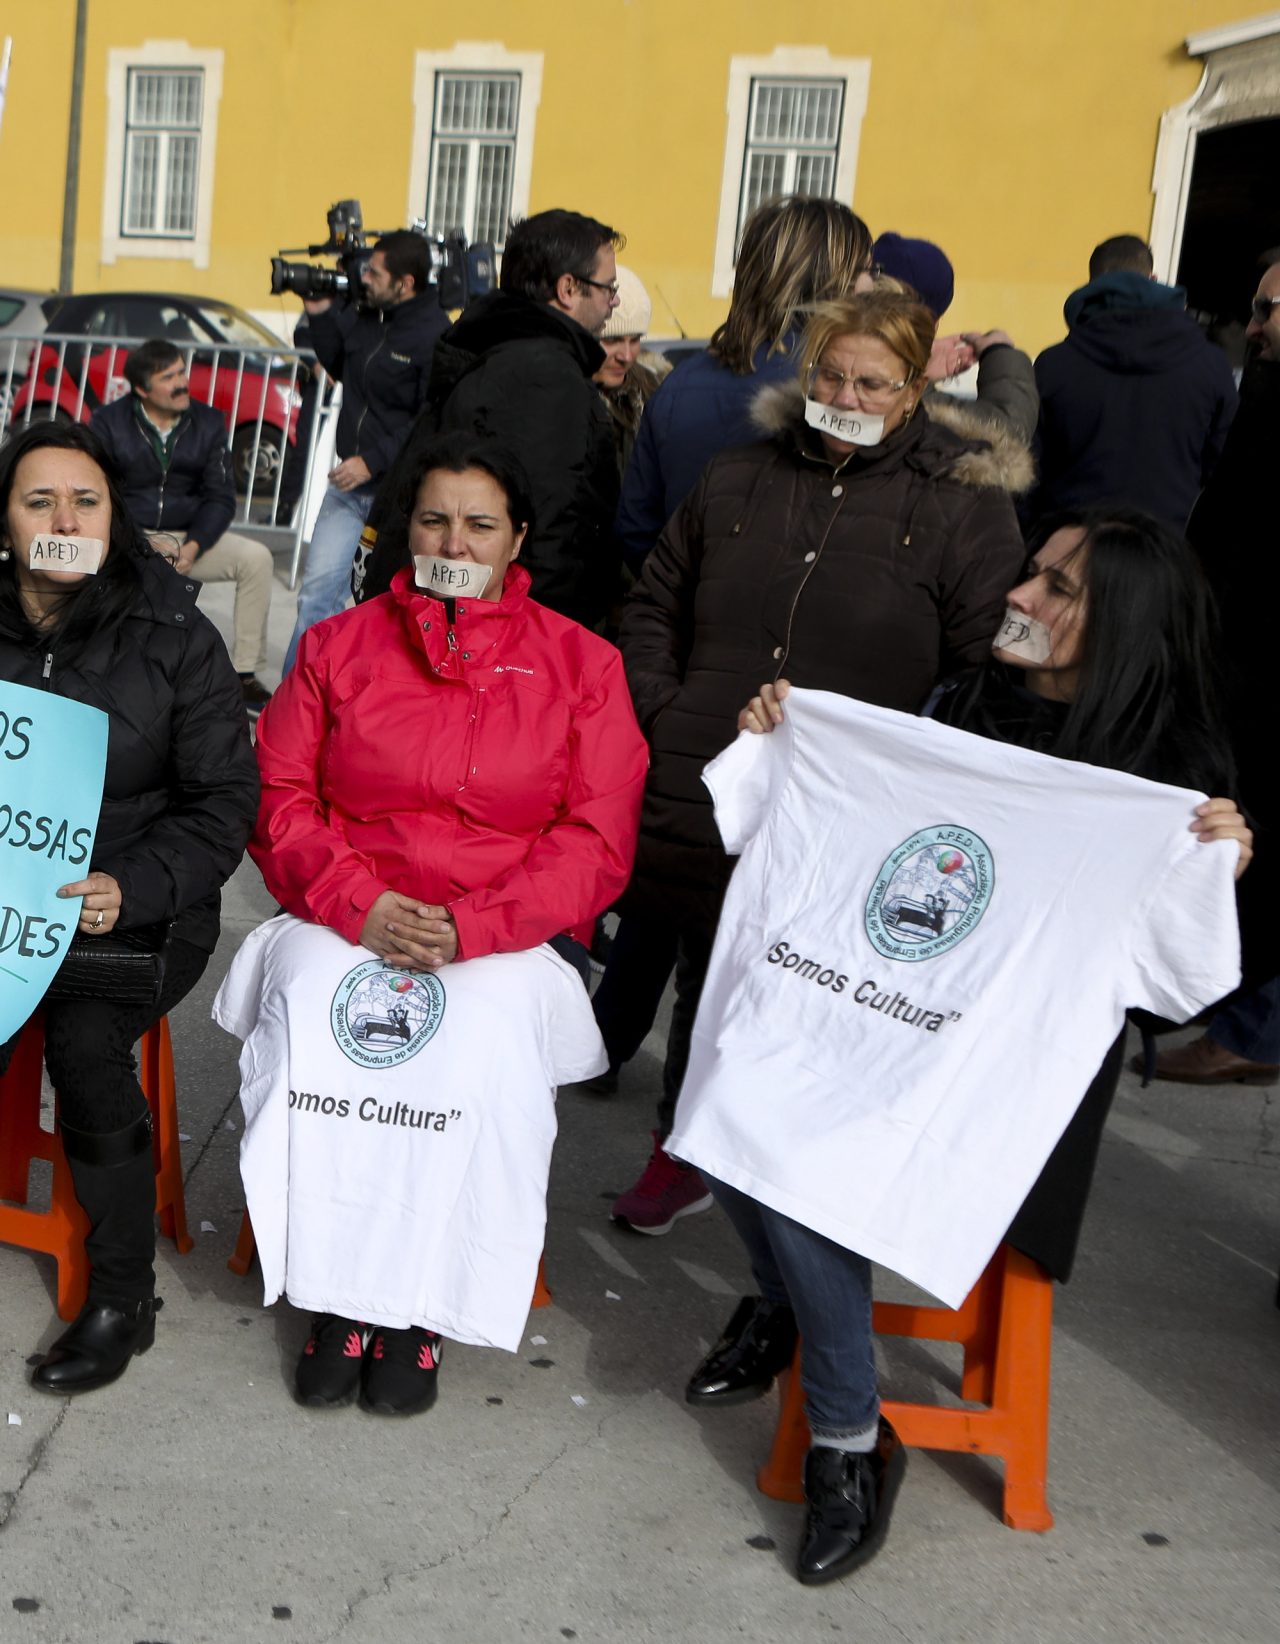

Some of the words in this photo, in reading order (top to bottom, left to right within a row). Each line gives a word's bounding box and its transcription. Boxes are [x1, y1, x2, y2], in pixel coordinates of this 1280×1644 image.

[343, 1037, 354, 1049] de
[351, 1048, 394, 1065] Empresas
[394, 1050, 407, 1060] de
